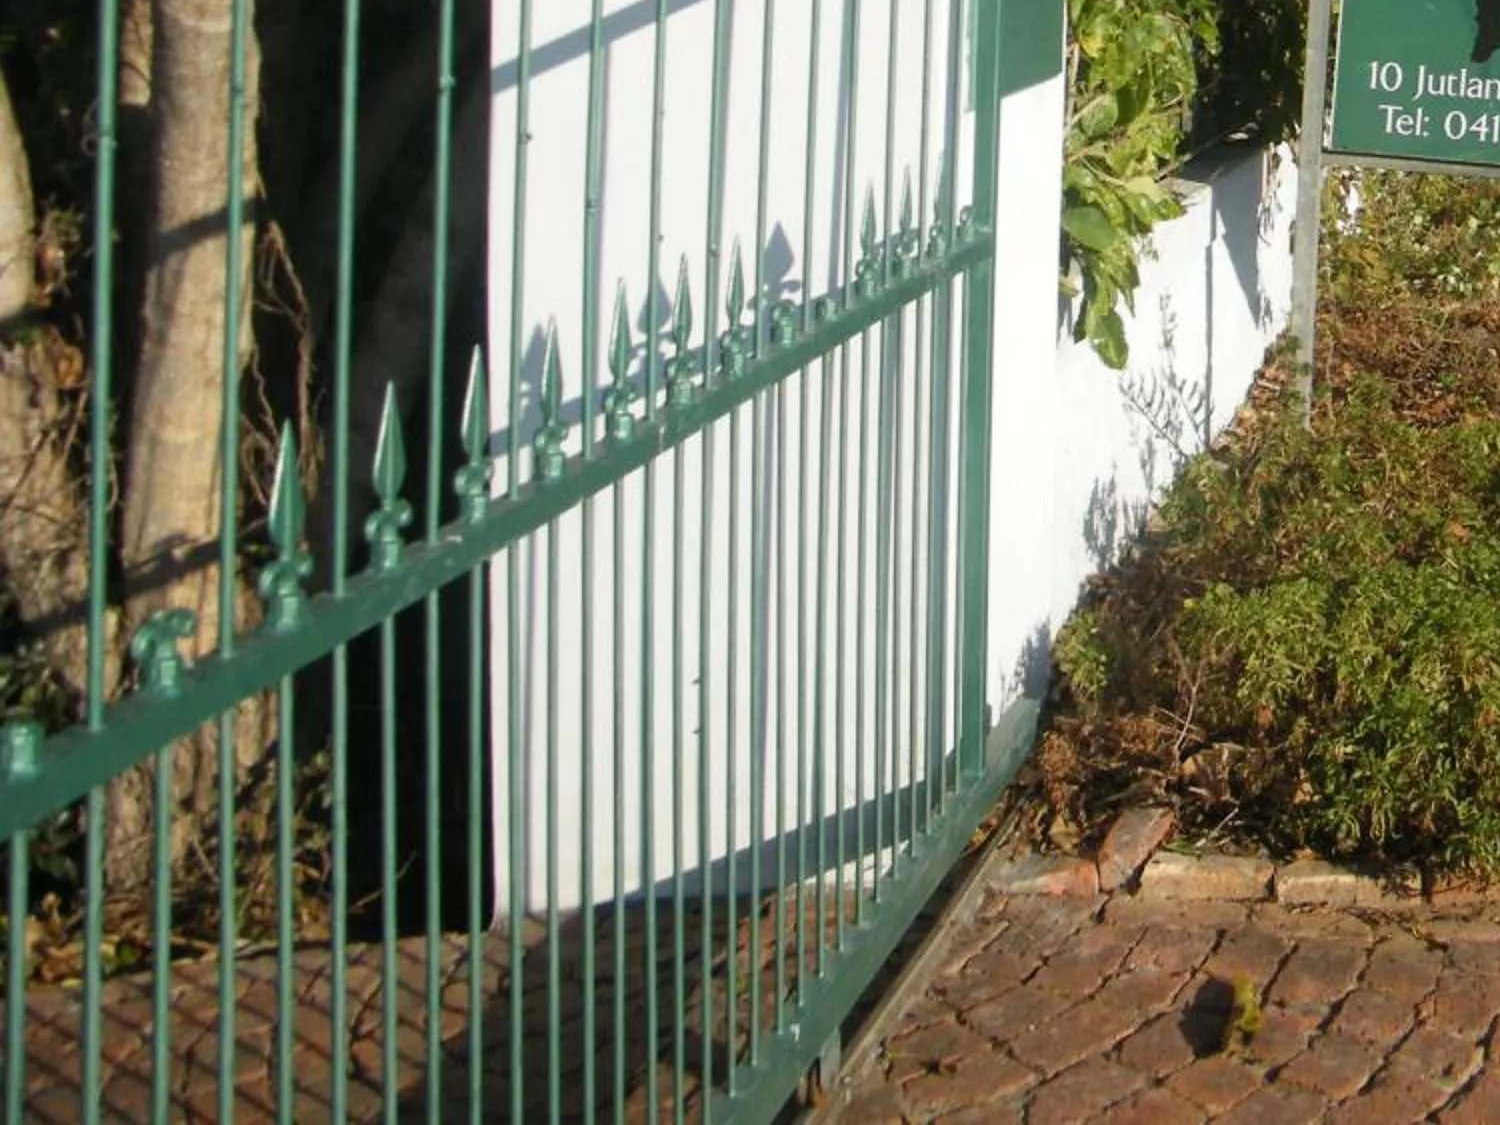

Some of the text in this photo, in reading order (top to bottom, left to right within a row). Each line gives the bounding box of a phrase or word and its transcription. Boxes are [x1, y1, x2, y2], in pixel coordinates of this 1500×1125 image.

[1368, 60, 1404, 92] 10
[1378, 104, 1430, 138] Tel:
[1443, 110, 1500, 144] 041
